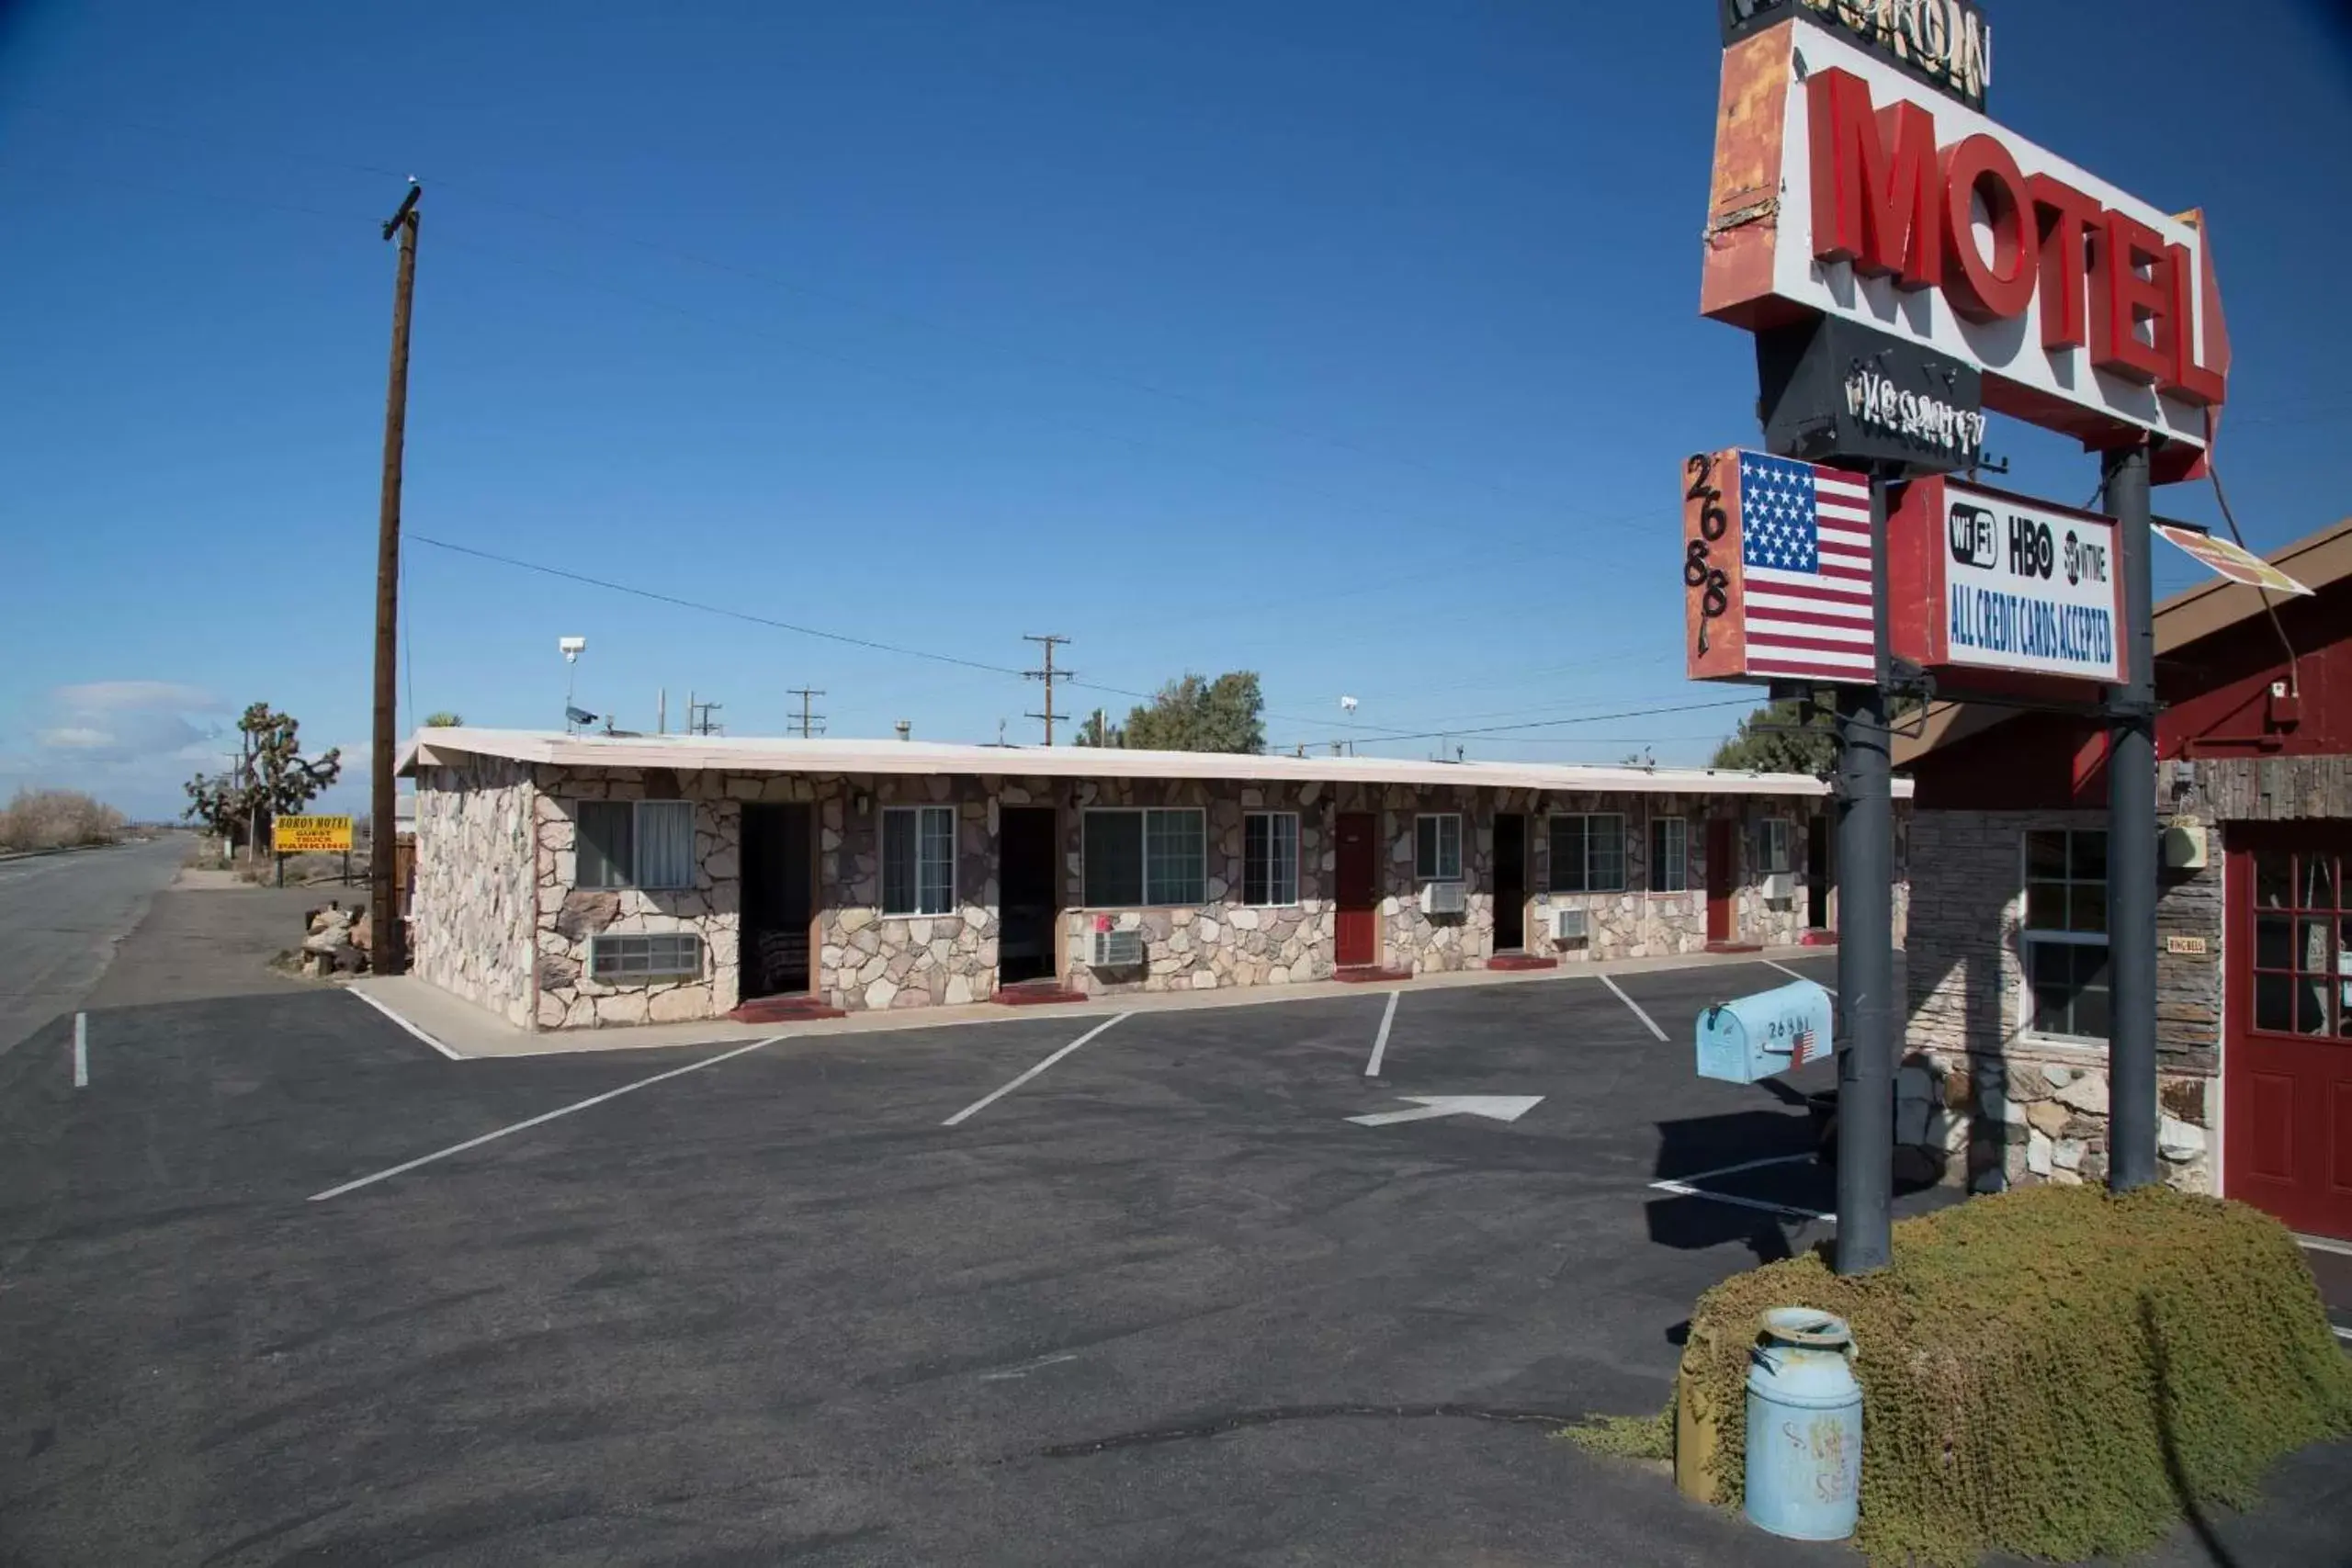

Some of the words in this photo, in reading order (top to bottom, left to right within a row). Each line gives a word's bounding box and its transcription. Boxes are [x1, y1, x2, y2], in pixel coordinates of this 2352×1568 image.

[1807, 66, 2224, 407] MOTEL
[1684, 454, 1729, 659] 26881
[2008, 514, 2054, 581] HBO
[1951, 582, 1973, 647] ALL
[1976, 588, 2018, 654] CREDIT
[2020, 596, 2057, 660] CARDS
[2060, 604, 2111, 664] ACCEPTED
[317, 816, 349, 829] MOTEL
